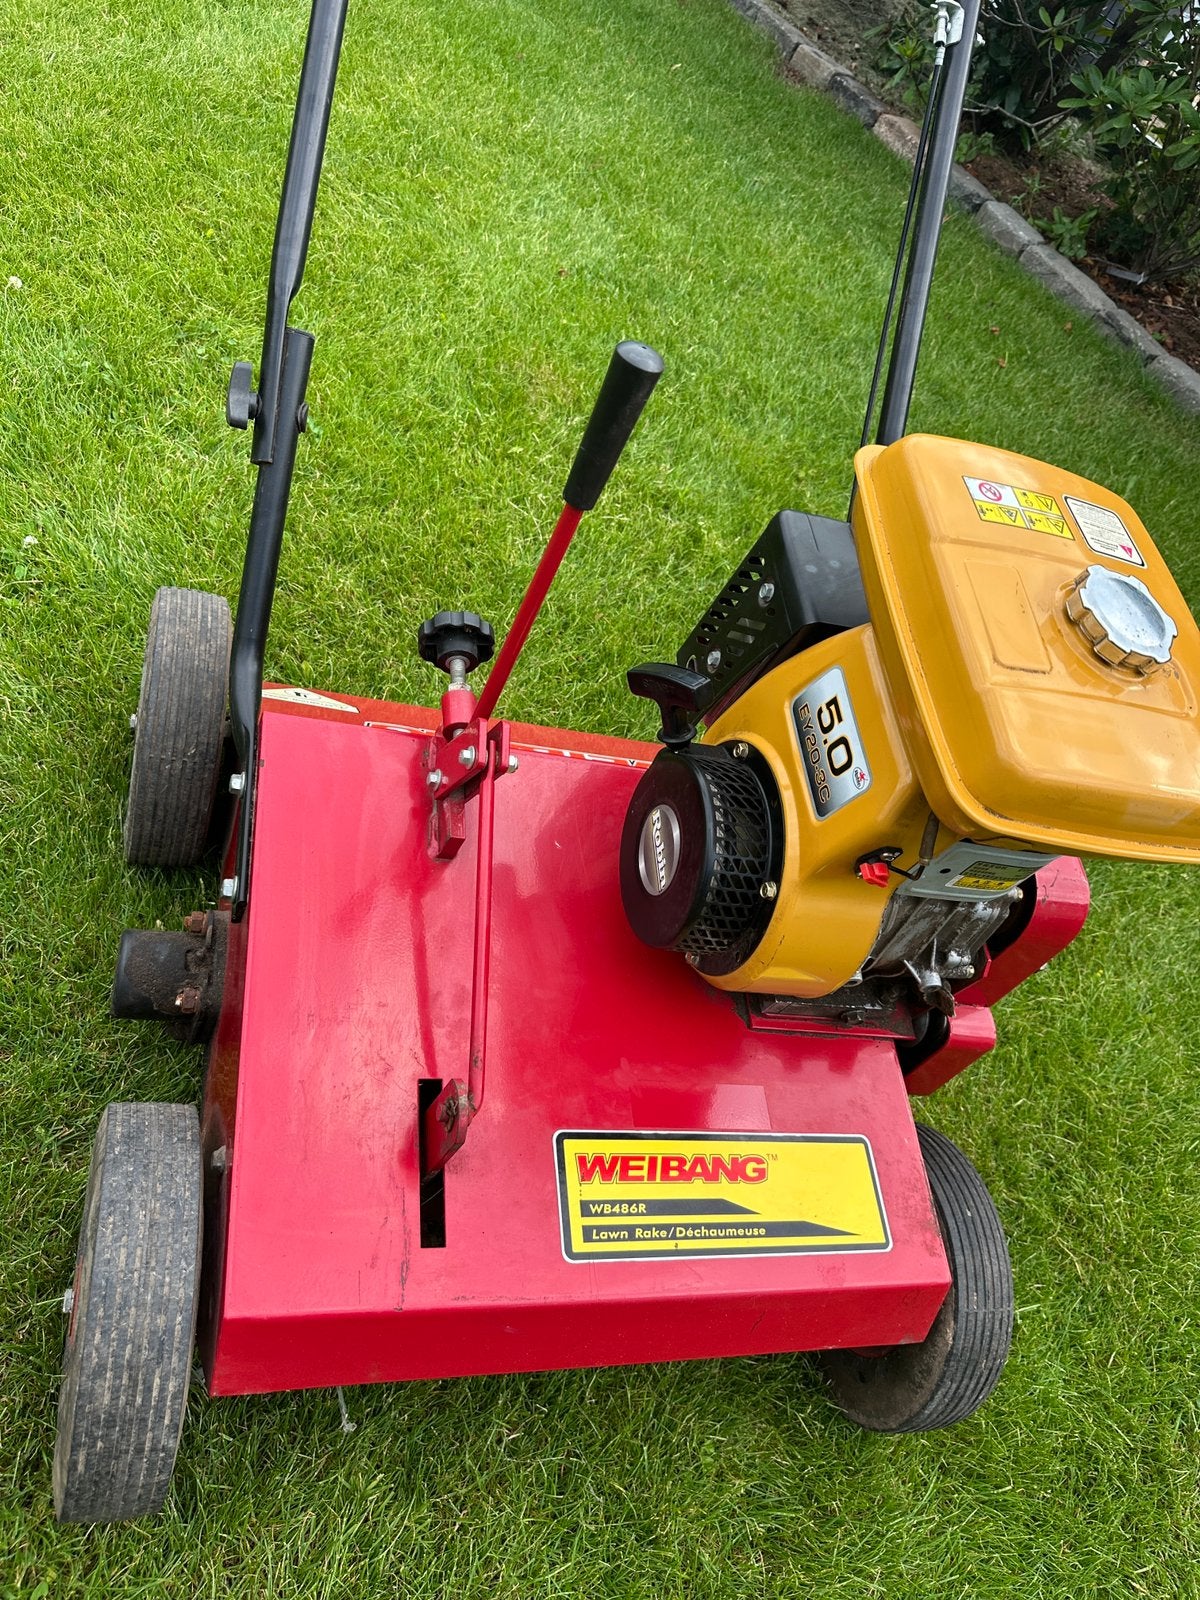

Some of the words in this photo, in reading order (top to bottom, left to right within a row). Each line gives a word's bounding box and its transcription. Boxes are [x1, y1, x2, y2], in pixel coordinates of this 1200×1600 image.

[799, 702, 831, 803] EY20-3C
[816, 695, 853, 777] 5.0
[651, 809, 666, 892] Robin
[575, 1153, 768, 1184] WEIBANG
[589, 1203, 647, 1214] WB486R
[592, 1228, 629, 1240] Lawn
[635, 1225, 767, 1239] Rake/Déchaumeuse
